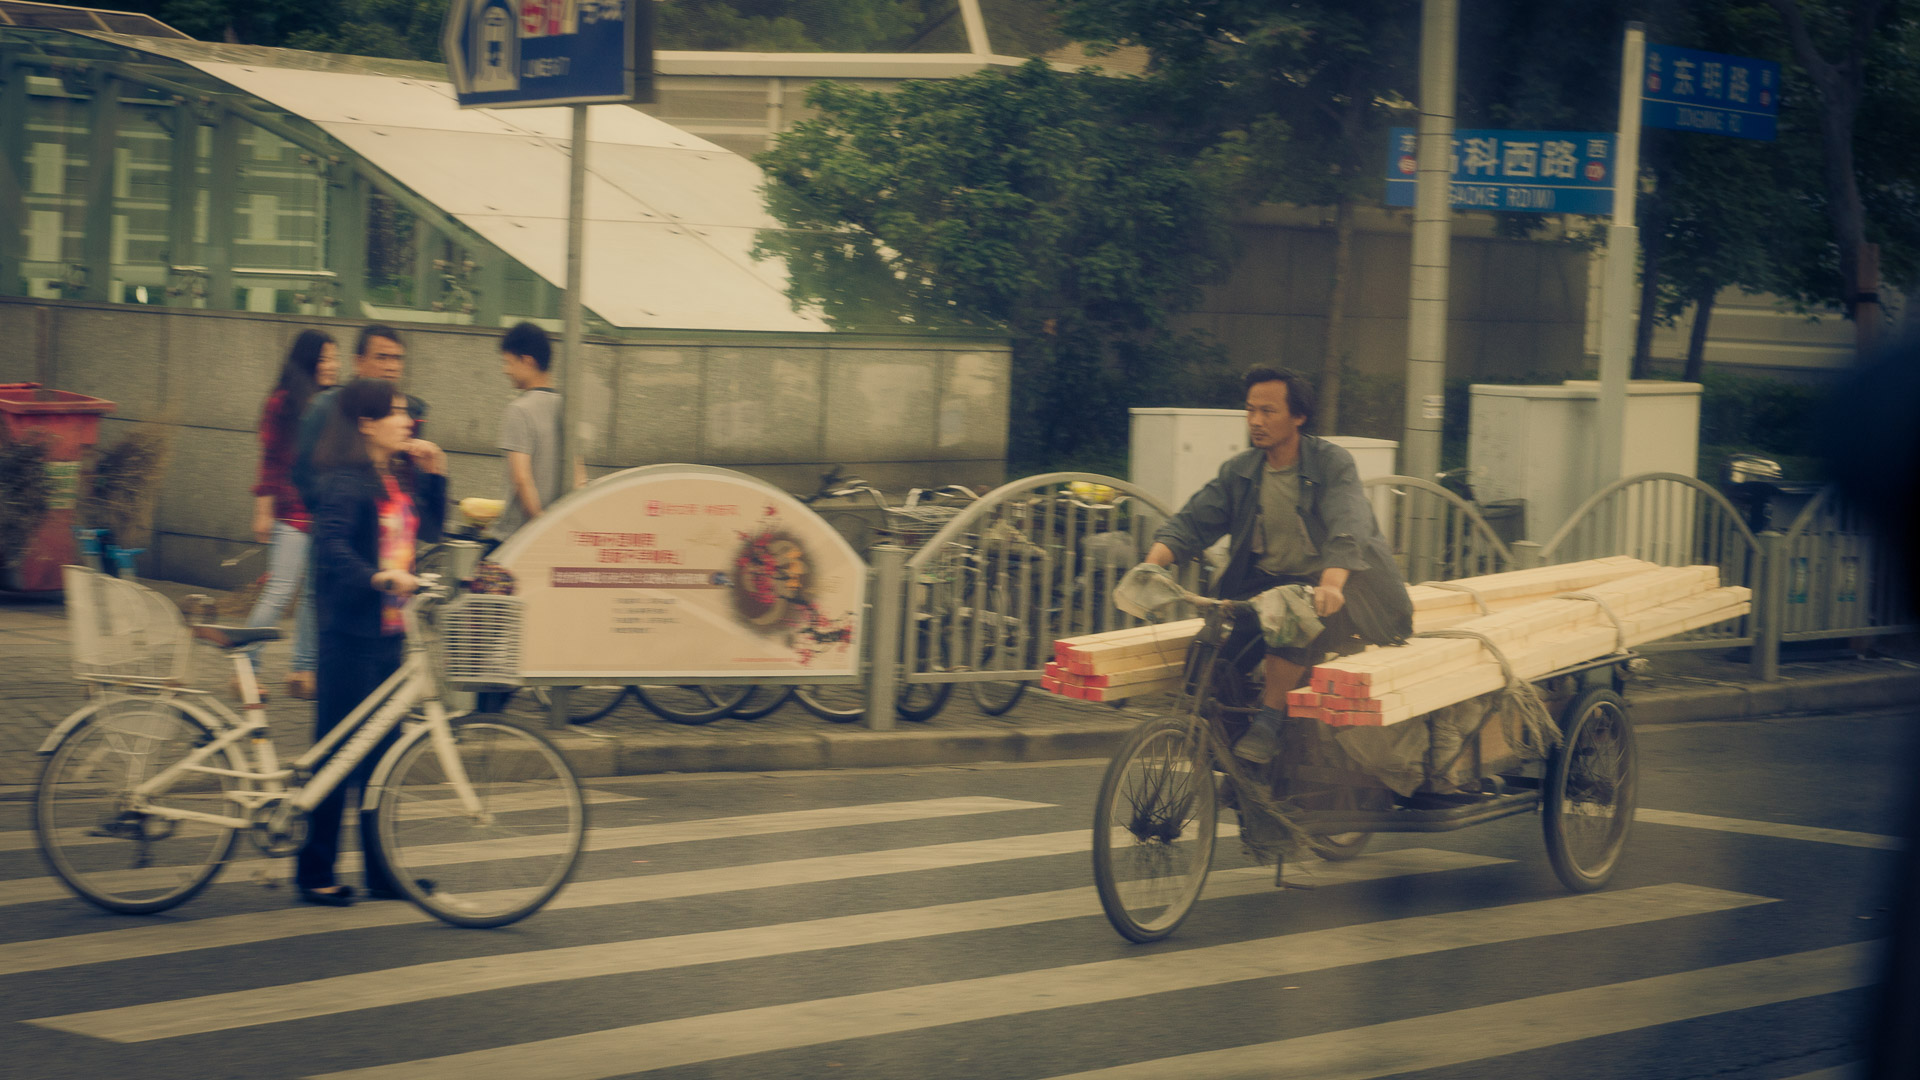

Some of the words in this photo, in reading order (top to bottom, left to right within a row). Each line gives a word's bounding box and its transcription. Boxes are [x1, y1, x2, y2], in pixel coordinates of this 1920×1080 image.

[1672, 57, 1750, 104] 东明路
[1449, 136, 1580, 179] 科西路
[1586, 138, 1609, 159] 西
